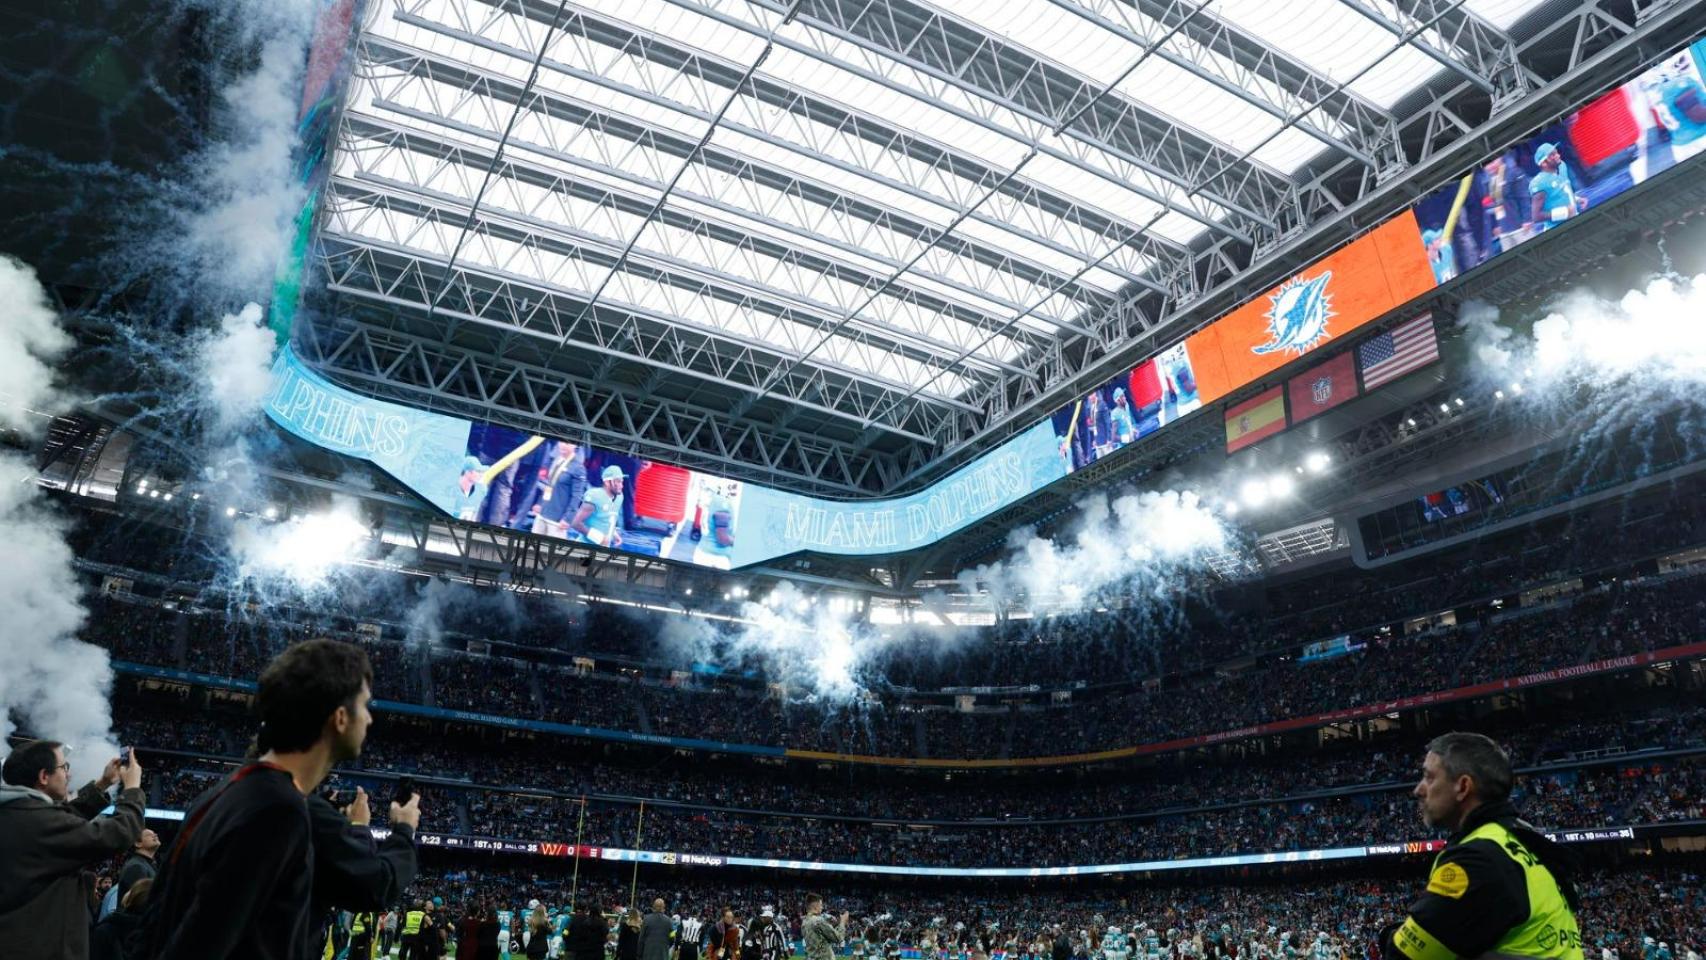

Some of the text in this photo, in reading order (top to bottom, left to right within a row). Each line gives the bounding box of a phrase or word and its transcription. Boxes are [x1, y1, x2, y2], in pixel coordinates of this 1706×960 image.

[784, 452, 1025, 548] MIAMI DOLPHINS
[1517, 655, 1637, 686] NATIONAL FOOTBALL LEAGUE
[421, 835, 441, 845] 9:23
[1565, 833, 1579, 841] 1ST
[1585, 832, 1594, 840] 10
[473, 840, 487, 848] 1ST
[493, 841, 502, 849] 10
[567, 846, 574, 855] 0
[1376, 845, 1400, 854] NetApp
[691, 852, 722, 866] NetApp
